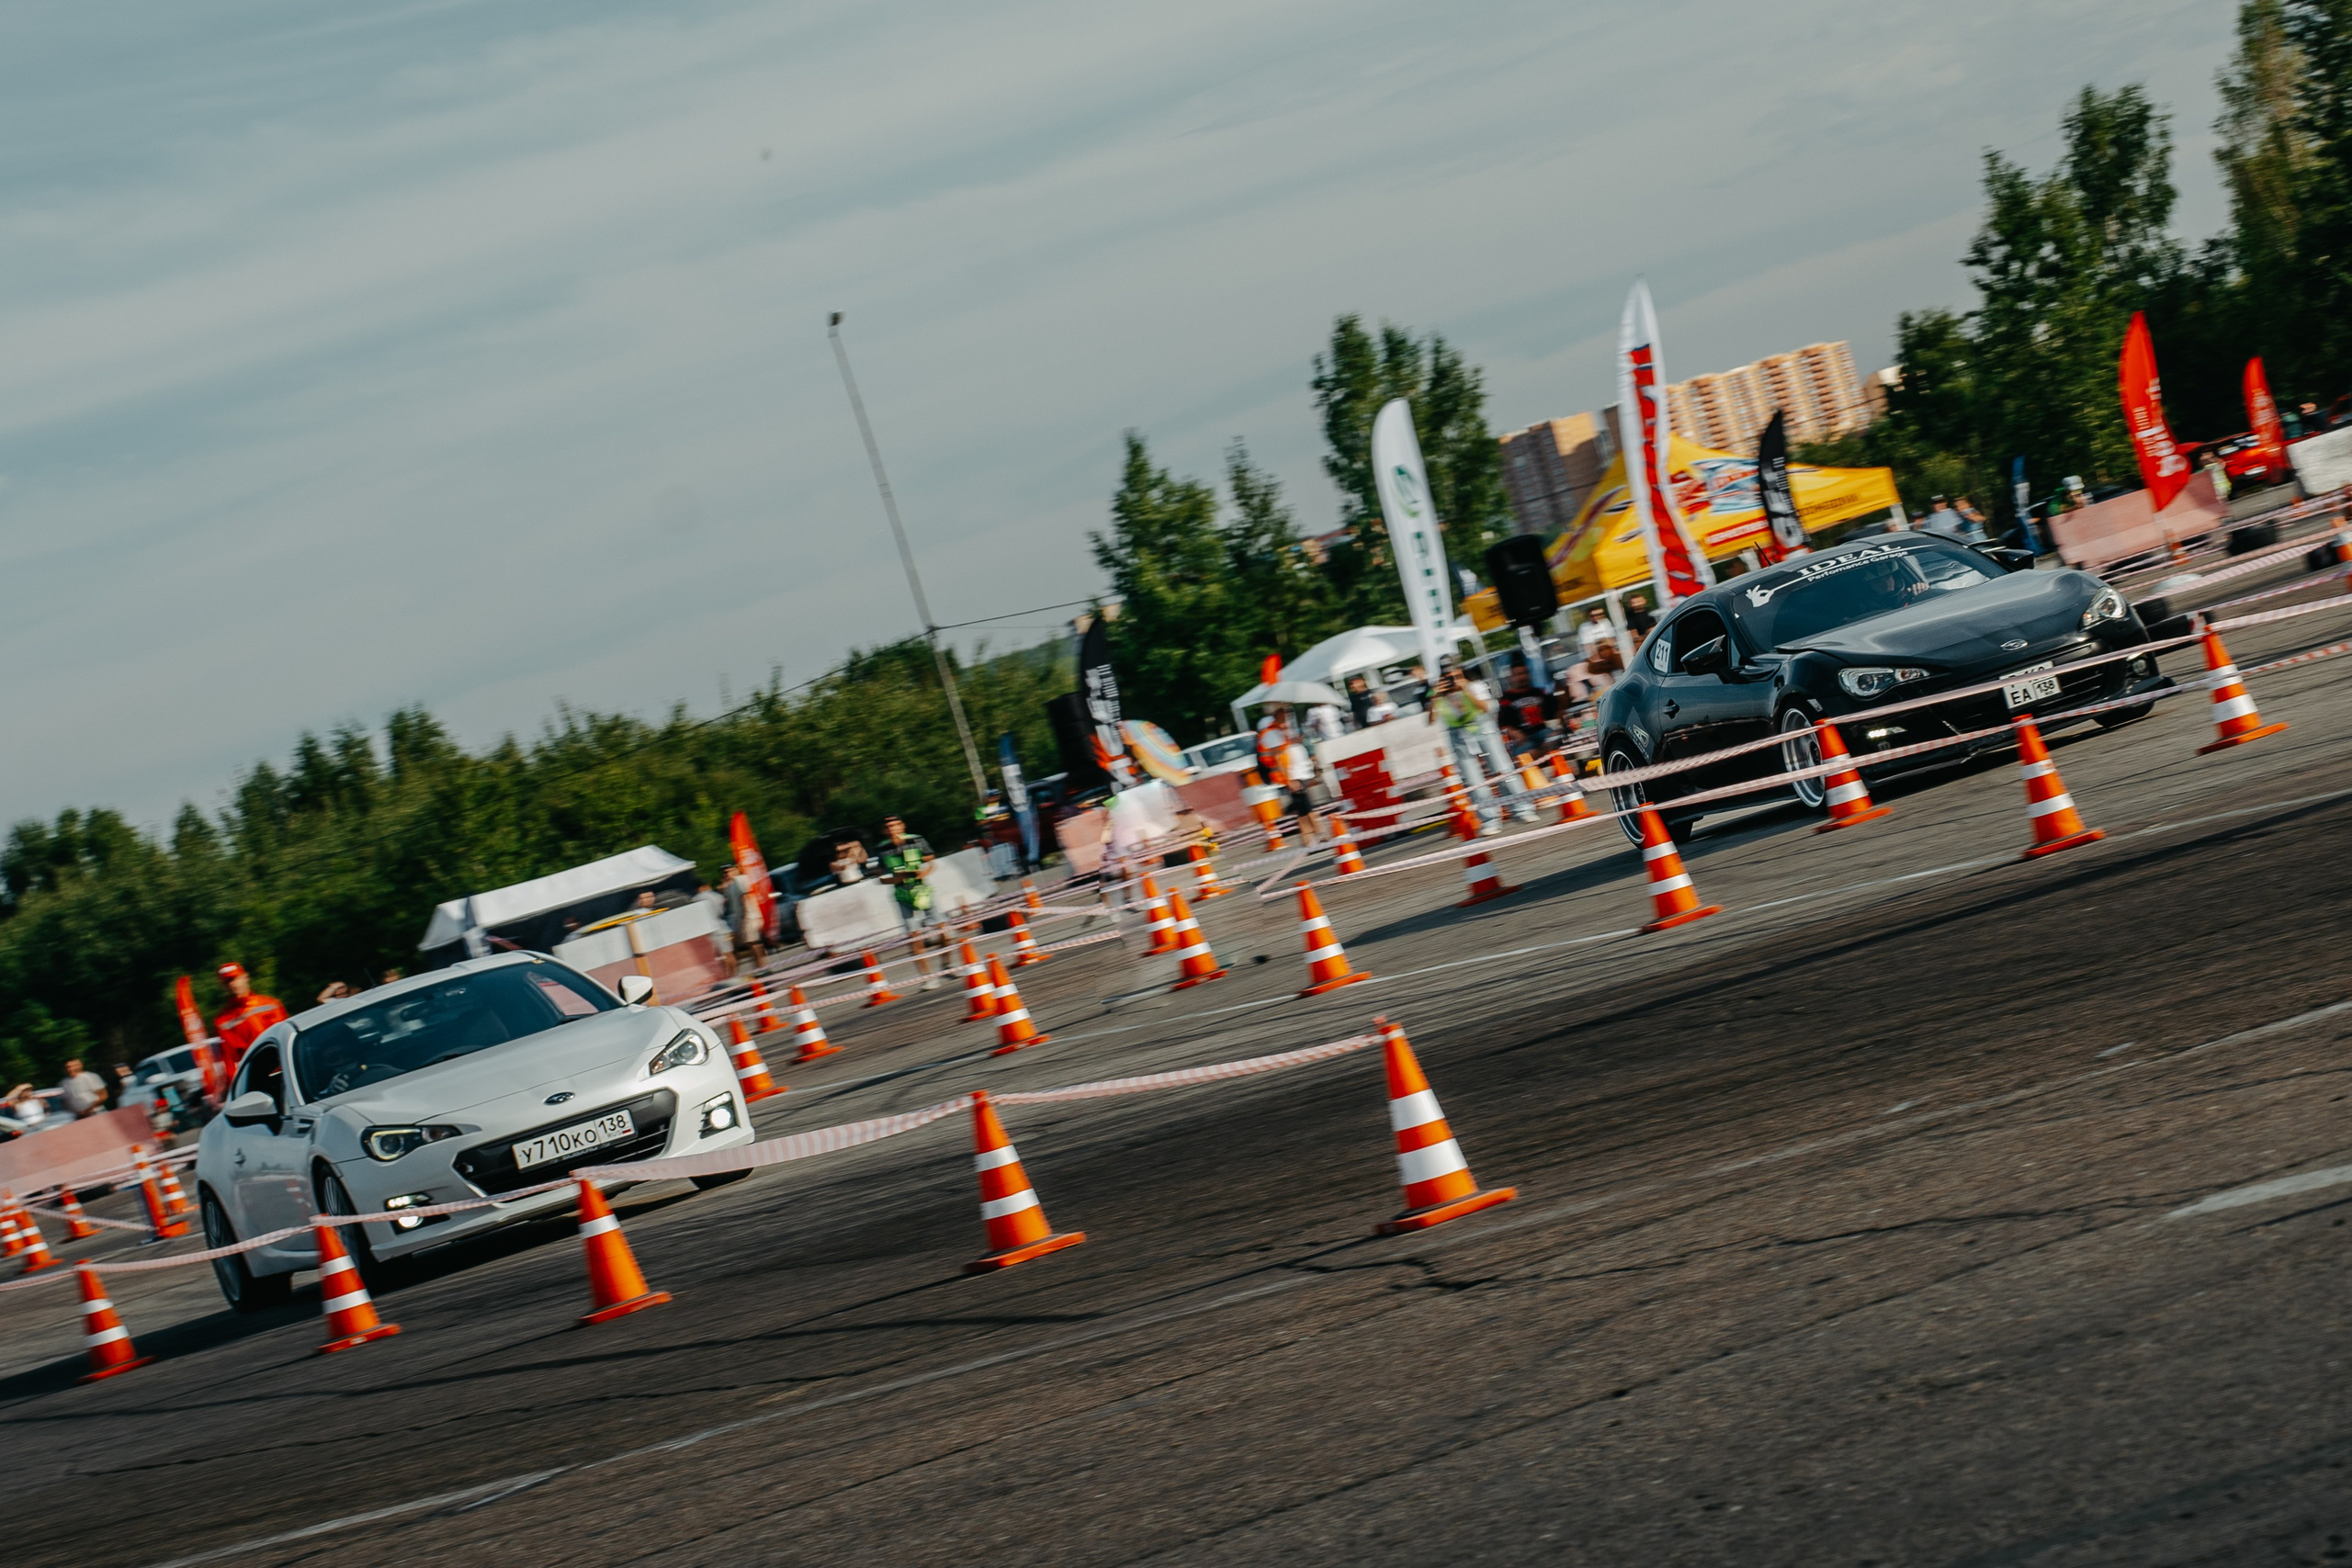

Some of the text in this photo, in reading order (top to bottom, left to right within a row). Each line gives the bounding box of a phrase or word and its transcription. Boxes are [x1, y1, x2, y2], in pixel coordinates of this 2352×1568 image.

[1797, 544, 1902, 577] IDEAL
[1870, 551, 1909, 563] Garage
[1657, 643, 1668, 662] 211
[2036, 680, 2055, 693] 138
[598, 1114, 627, 1134] 138
